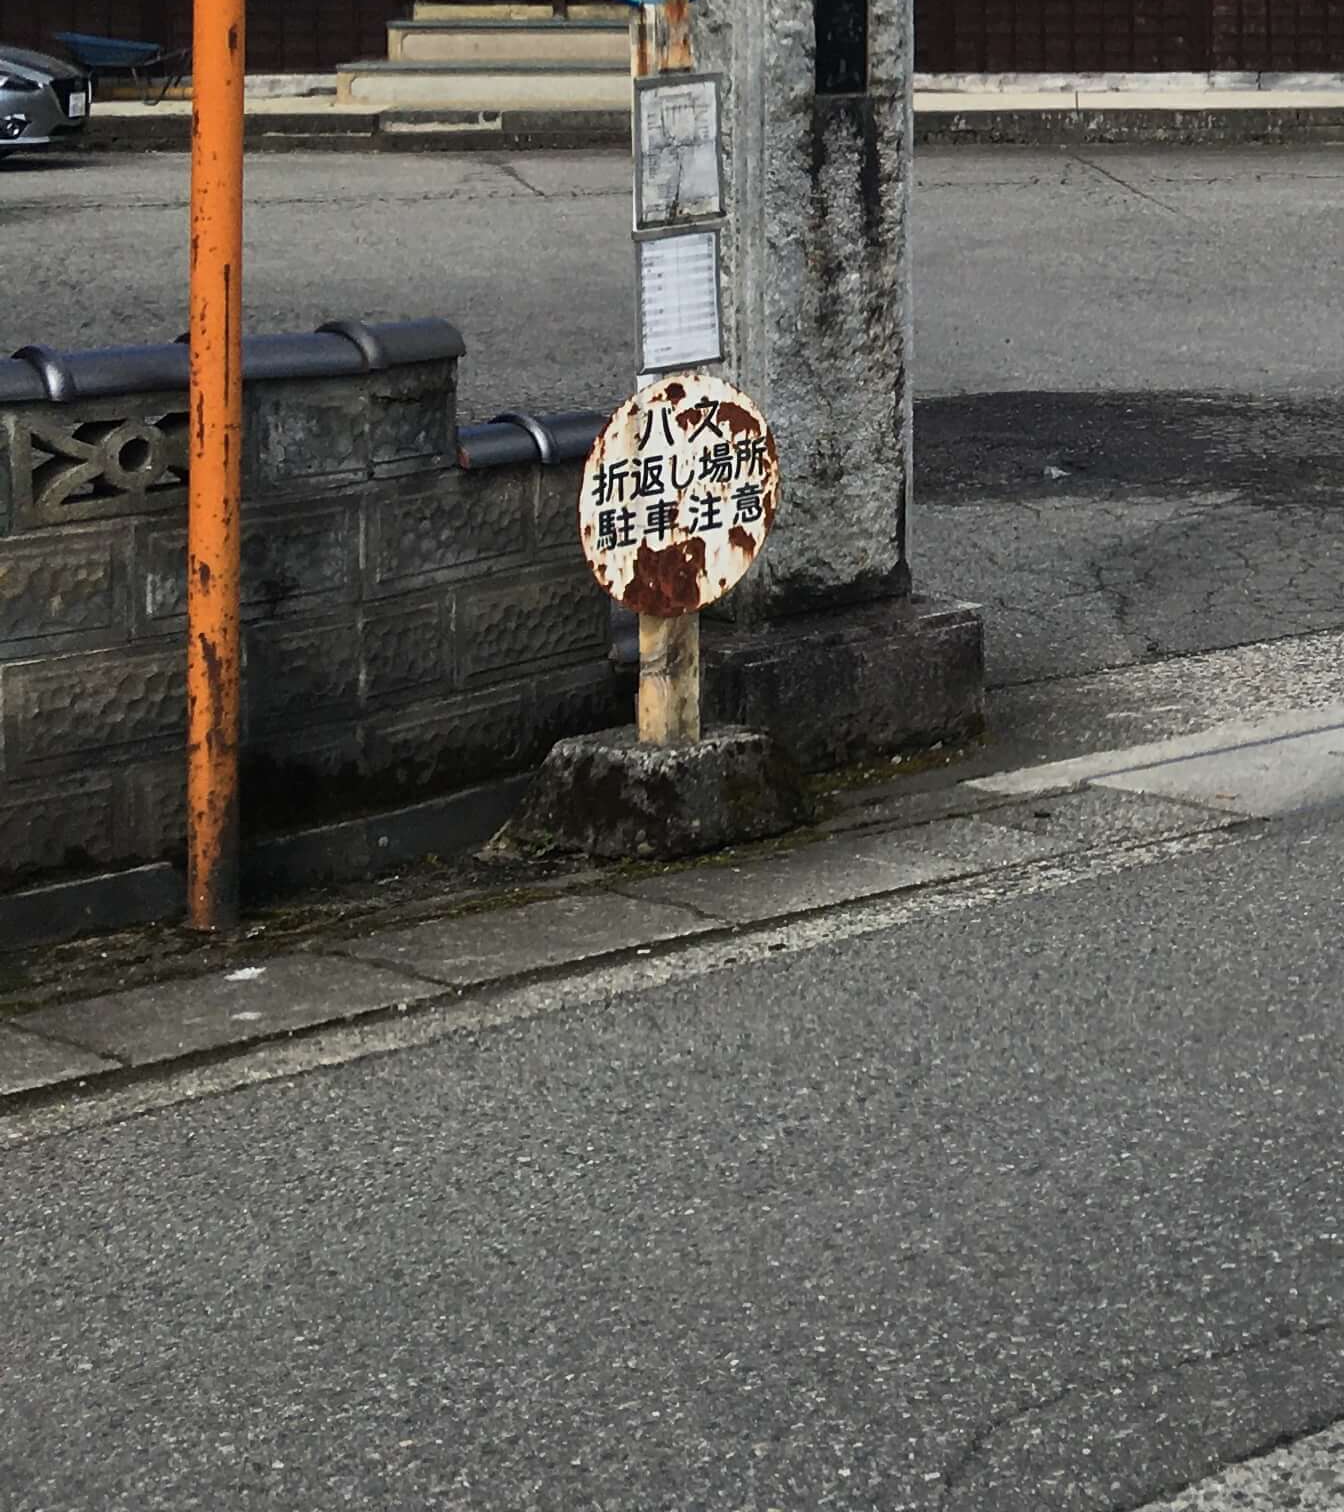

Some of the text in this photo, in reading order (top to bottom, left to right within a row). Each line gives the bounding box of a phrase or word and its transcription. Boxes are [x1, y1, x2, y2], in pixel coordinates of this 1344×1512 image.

[637, 395, 724, 452] バス
[591, 436, 767, 506] 折返し場所
[595, 481, 764, 551] 駐車注意
